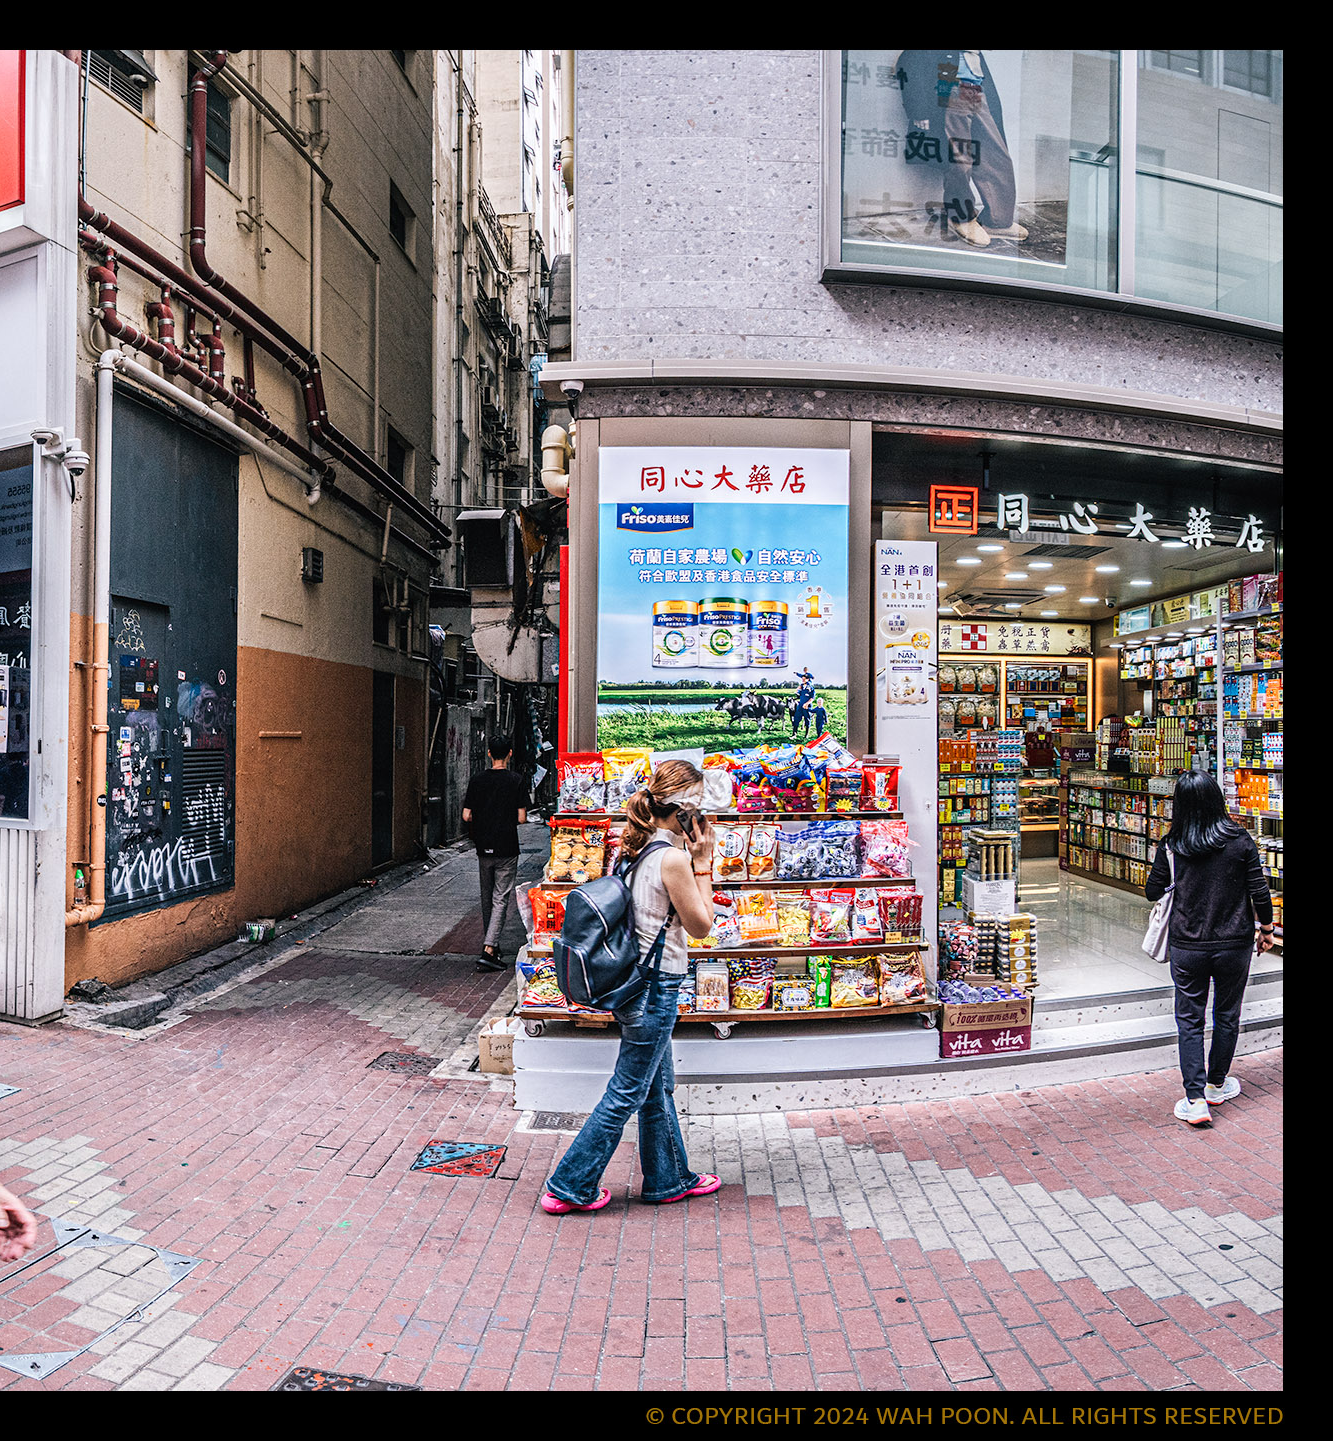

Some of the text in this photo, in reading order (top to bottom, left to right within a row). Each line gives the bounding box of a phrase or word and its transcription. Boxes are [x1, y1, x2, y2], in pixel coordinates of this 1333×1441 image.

[640, 463, 808, 495] 同心大藥店
[621, 512, 656, 524] Friso
[656, 514, 690, 524] 美素佳兒
[996, 492, 1266, 553] 同心大藥店
[629, 548, 822, 566] 荷蘭自家農場 自然安心
[881, 548, 900, 556] NAN
[638, 570, 809, 584] 符合歐盟及香港食品安全標準
[881, 564, 934, 577] 全港首創
[997, 624, 1051, 638] 免稅正貨
[956, 1013, 977, 1024] 100%
[949, 1032, 983, 1050] vita
[991, 1029, 1025, 1047] vita
